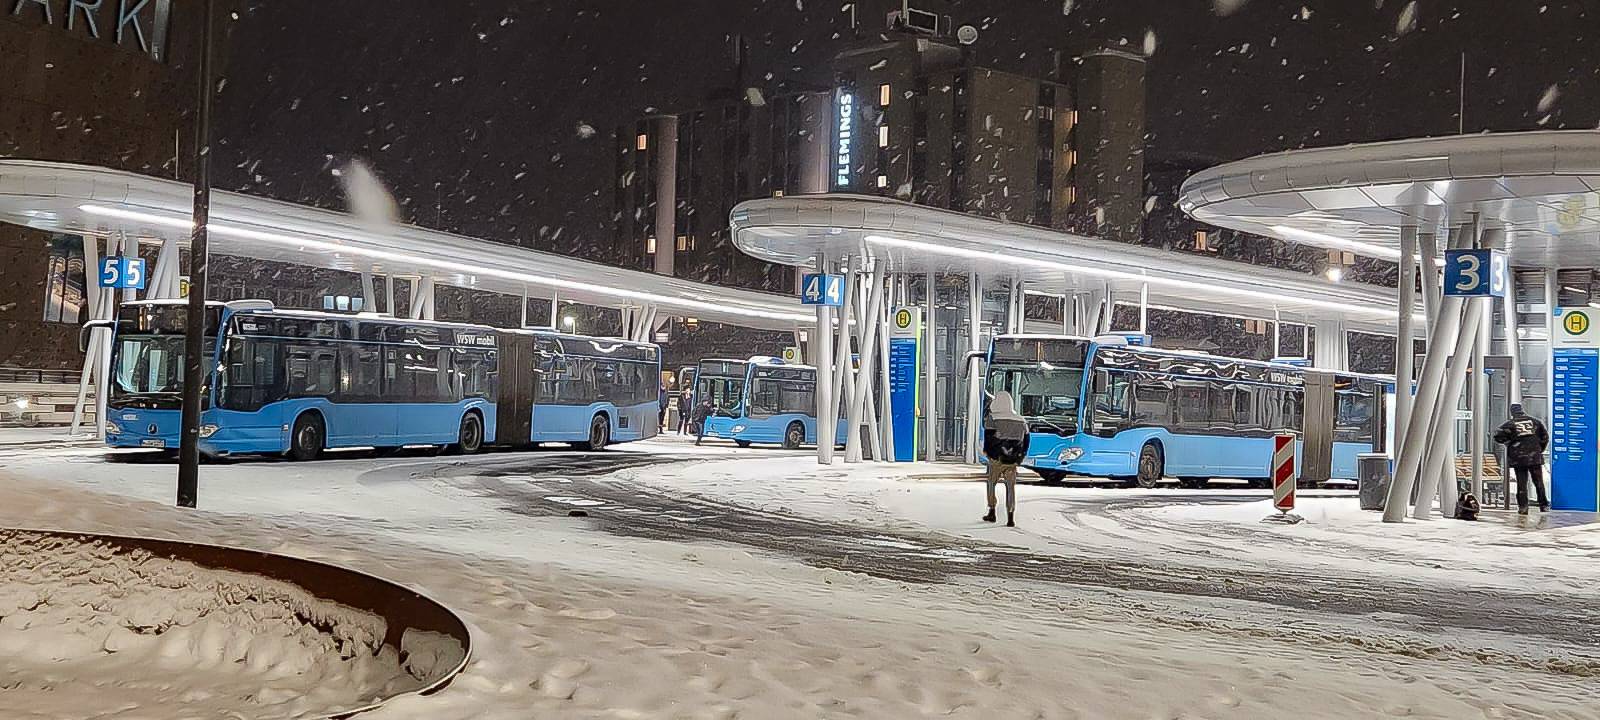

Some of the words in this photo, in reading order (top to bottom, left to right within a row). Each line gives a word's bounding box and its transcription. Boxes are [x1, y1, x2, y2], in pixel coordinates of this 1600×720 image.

[838, 94, 852, 186] FLEMINGS
[103, 259, 119, 284] 5
[127, 260, 141, 285] 5
[1455, 254, 1480, 291] 3
[1493, 255, 1504, 291] 3
[805, 276, 820, 301] 4
[827, 277, 840, 303] 4
[900, 313, 907, 325] H
[1571, 315, 1582, 331] H
[457, 334, 475, 345] WSW
[476, 335, 495, 346] mobil
